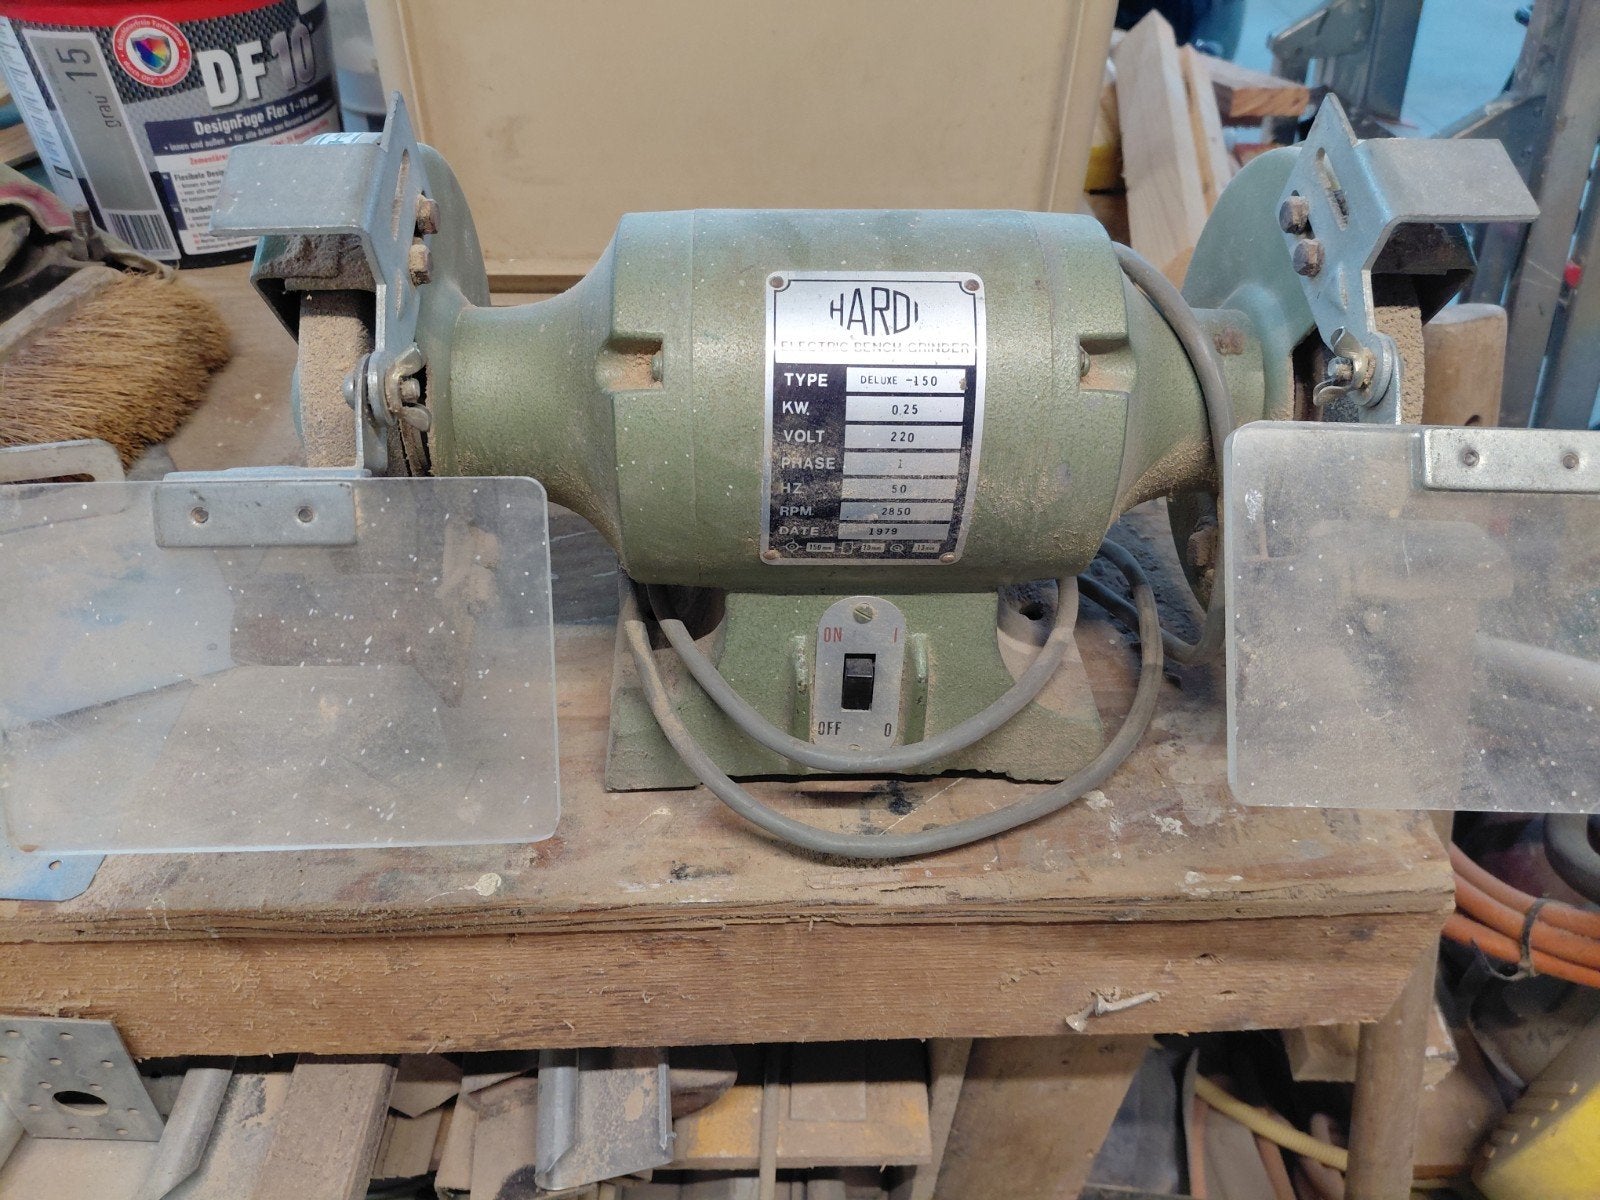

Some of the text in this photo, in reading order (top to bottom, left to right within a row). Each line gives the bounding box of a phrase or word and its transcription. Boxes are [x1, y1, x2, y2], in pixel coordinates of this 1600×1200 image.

[197, 24, 317, 108] DF 10
[57, 47, 122, 129] grau 15
[194, 111, 265, 136] DesignFuge
[266, 103, 289, 121] Flex
[829, 286, 919, 337] HARDI
[780, 340, 970, 355] ELECTRIC BENCH GRINDER
[783, 372, 828, 388] TYPE
[860, 374, 898, 386] DELUXE
[891, 403, 919, 417] 0.25
[783, 429, 915, 444] VOLT 220
[781, 456, 836, 470] PHASE
[891, 483, 907, 494] 50
[881, 506, 911, 516] 2850
[778, 525, 898, 537] DATE 1979
[823, 626, 843, 643] ON
[817, 721, 842, 736] OFF
